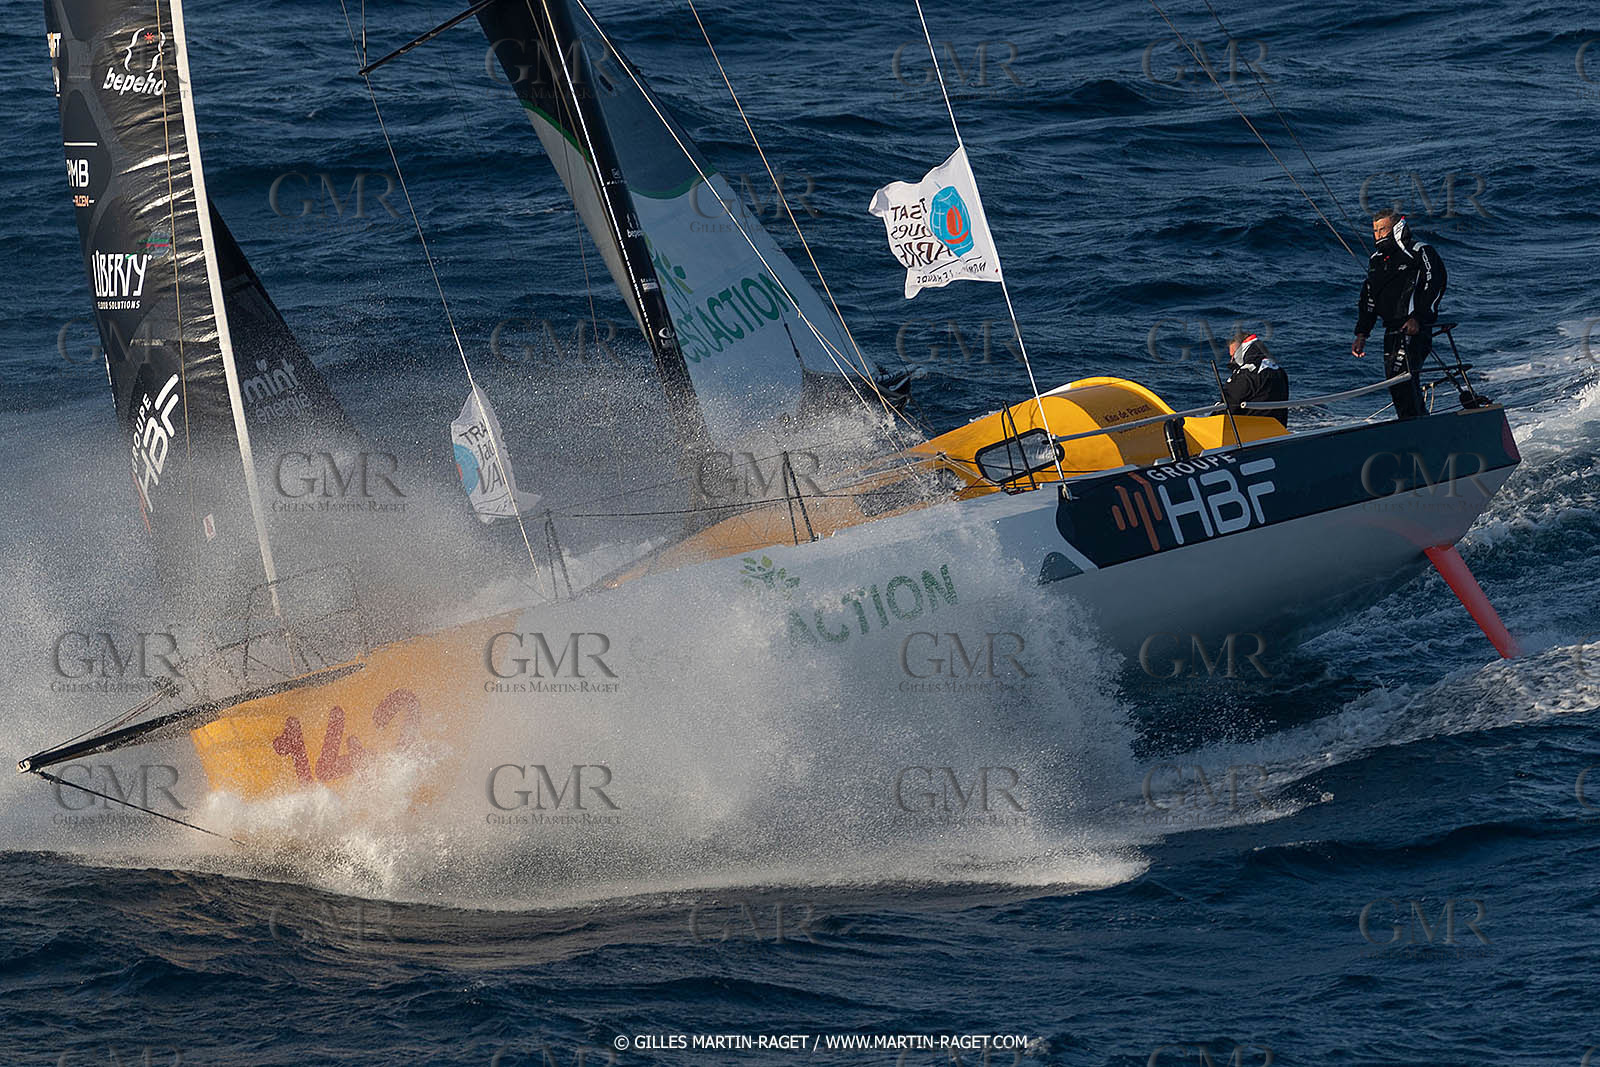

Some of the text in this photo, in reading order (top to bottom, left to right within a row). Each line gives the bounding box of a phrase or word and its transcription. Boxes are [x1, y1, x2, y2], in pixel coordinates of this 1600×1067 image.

[103, 67, 167, 96] bepeho
[91, 249, 148, 297] LIBERTY
[109, 300, 141, 310] SOLUTIONS
[243, 358, 298, 403] mint
[138, 373, 179, 513] HBF
[1147, 452, 1237, 482] GROUPE
[1157, 457, 1276, 546] HBF
[789, 563, 959, 649] ACTION
